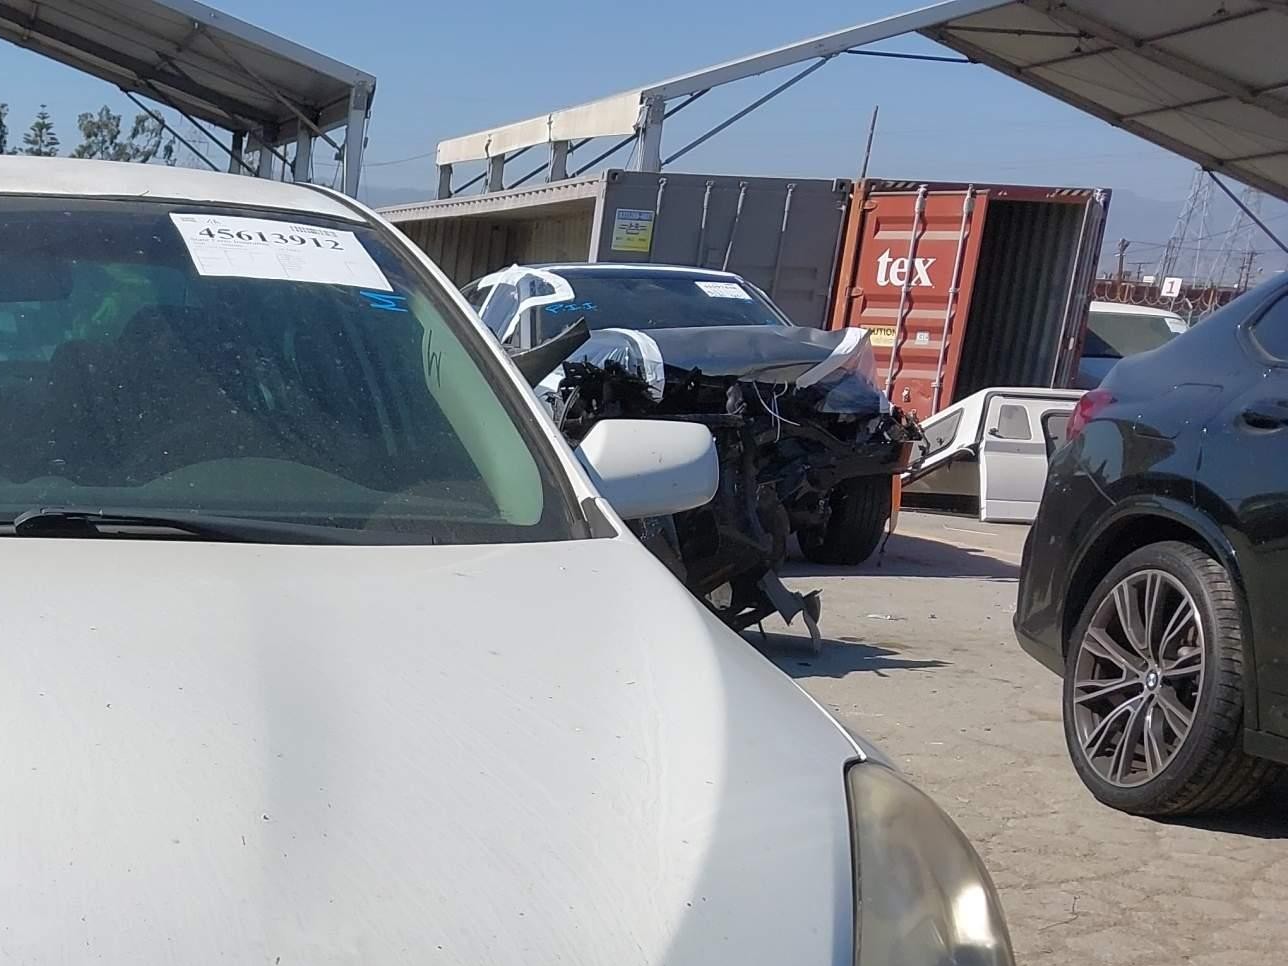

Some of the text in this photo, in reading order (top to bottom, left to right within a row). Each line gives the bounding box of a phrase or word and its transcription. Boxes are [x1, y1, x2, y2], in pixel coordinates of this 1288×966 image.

[198, 227, 345, 251] 45613912
[876, 248, 937, 287] tex
[1166, 280, 1176, 294] 1
